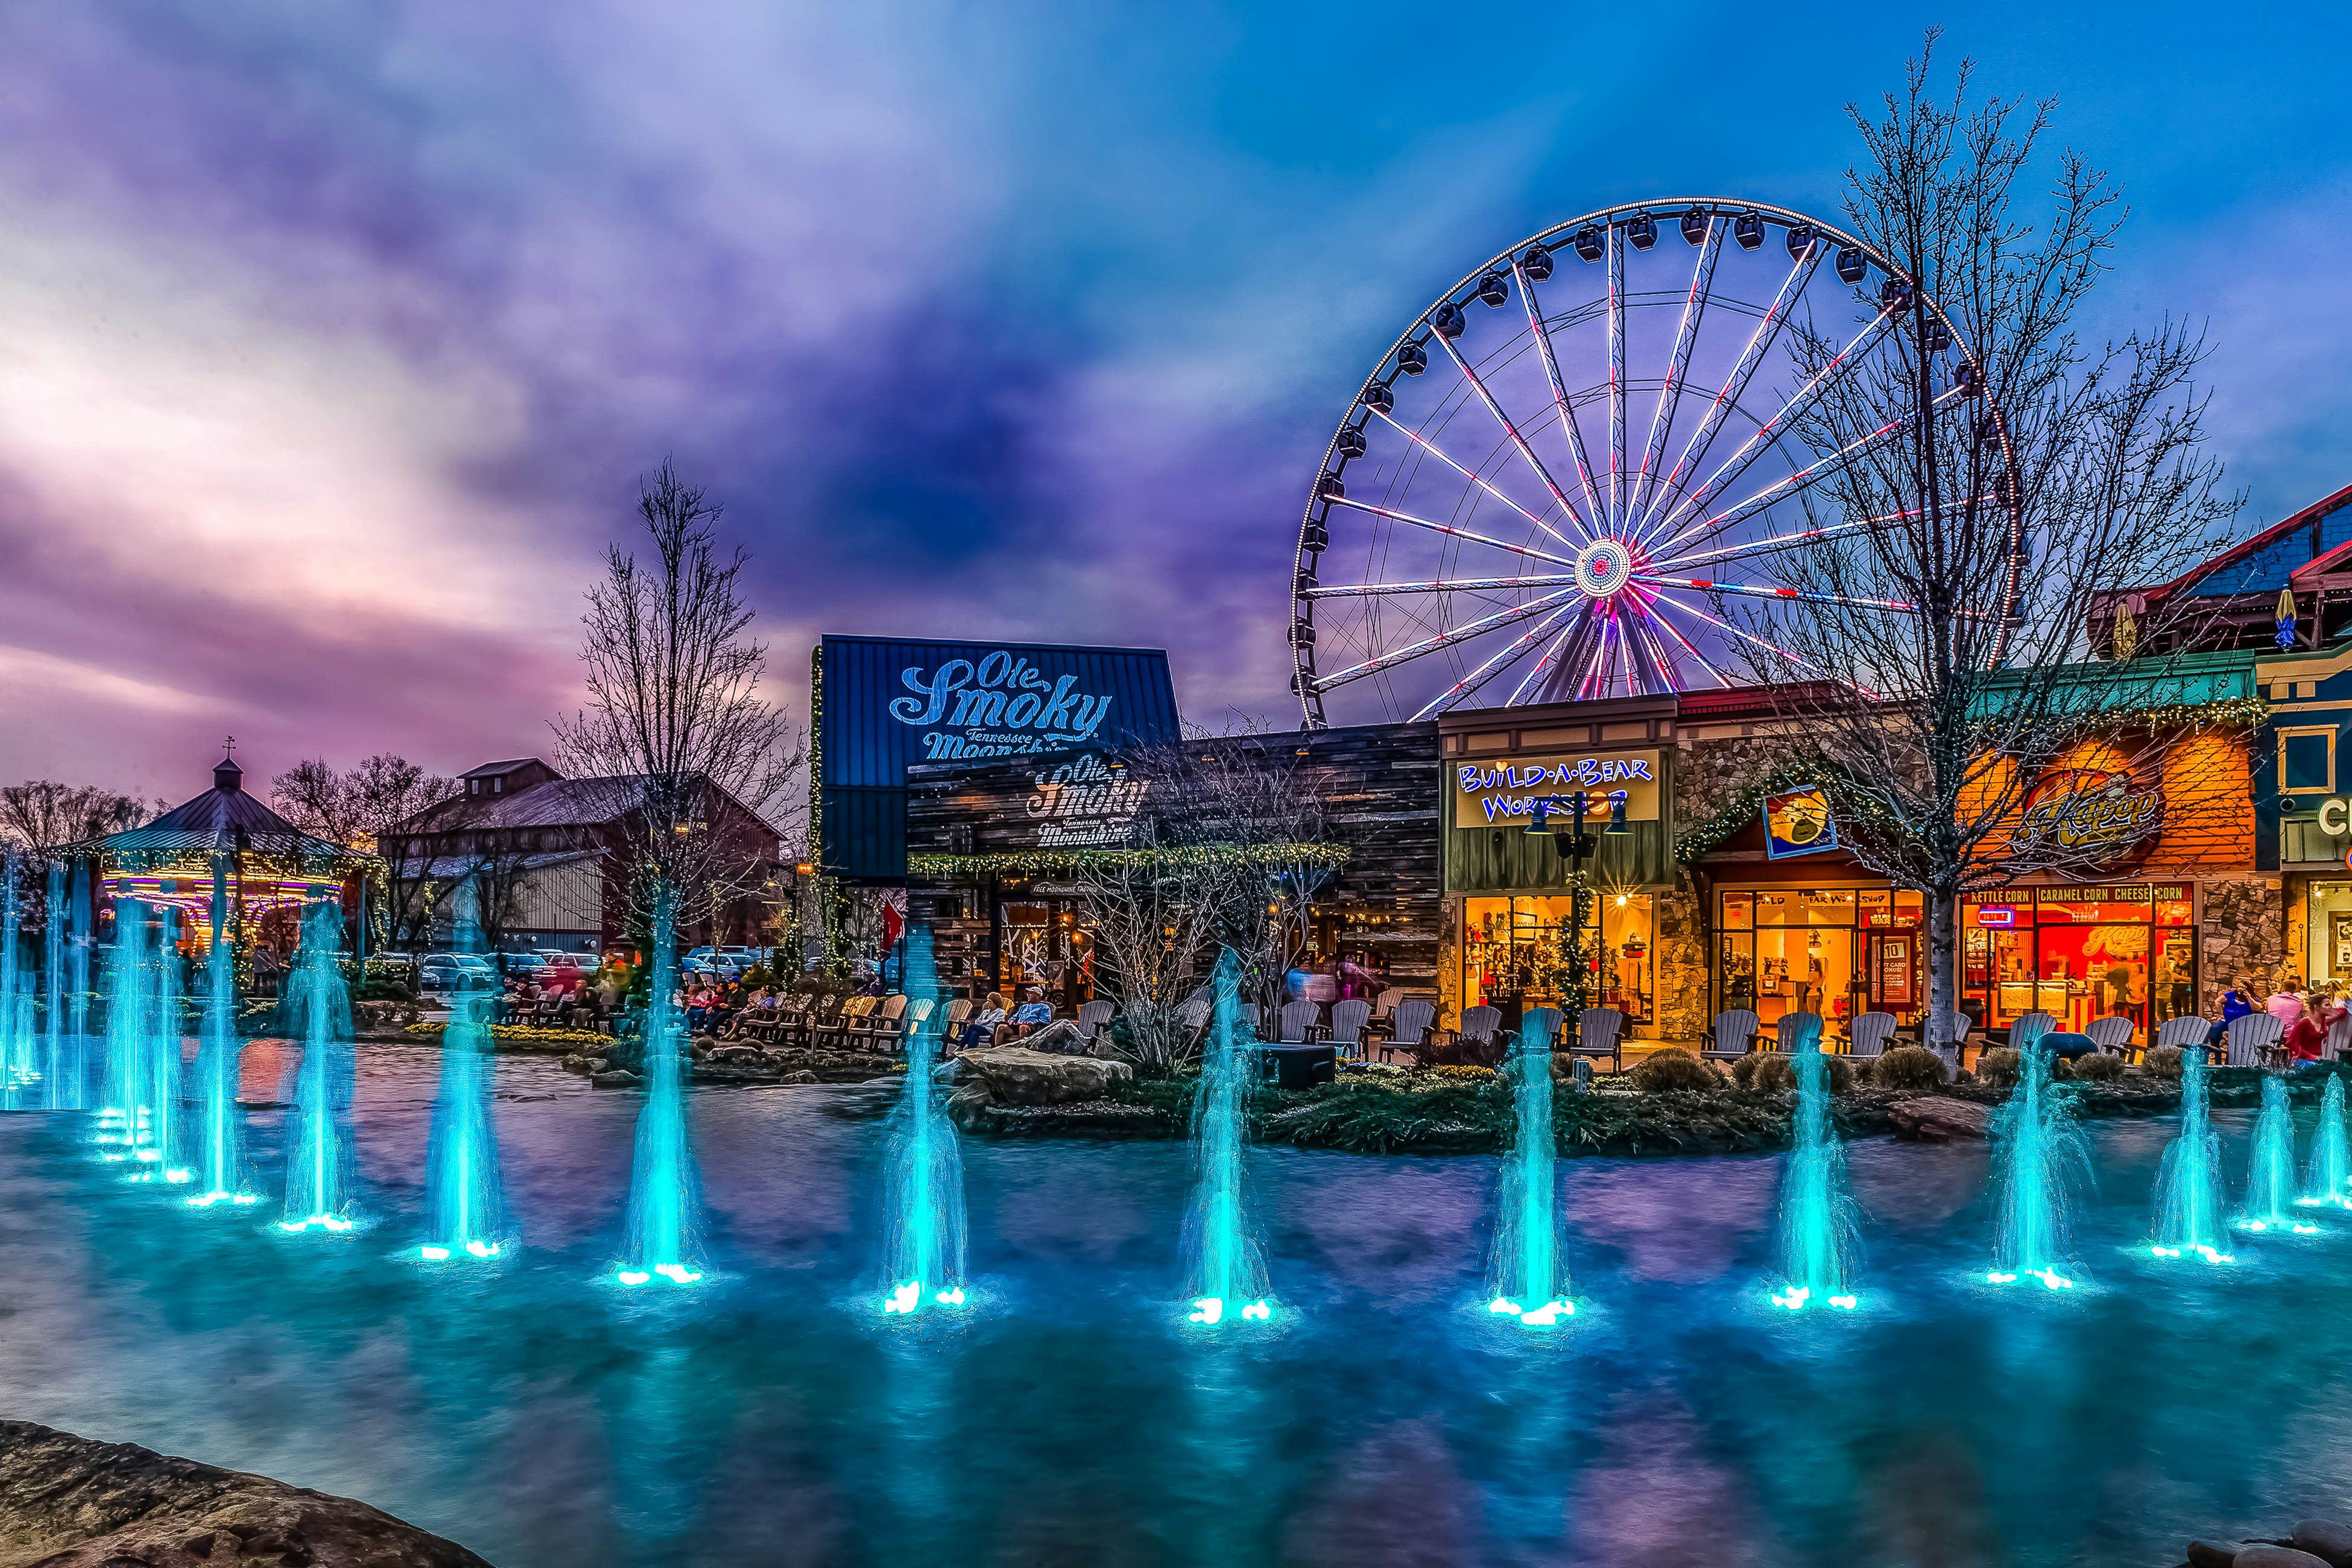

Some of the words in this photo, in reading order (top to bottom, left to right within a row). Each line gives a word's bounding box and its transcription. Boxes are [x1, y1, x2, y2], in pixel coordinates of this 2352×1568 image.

[977, 650, 1051, 692] Ole
[890, 659, 1112, 742] Smoky
[966, 728, 1032, 744] Tennessee
[1026, 765, 1151, 824] Smoky
[1037, 823, 1133, 847] Moonshine
[1971, 891, 2003, 903] KETTLE
[2005, 891, 2029, 902] CORN
[2041, 889, 2081, 901] CARAMEL
[2084, 889, 2108, 901] CORN
[2115, 888, 2149, 900] CHEESE
[2158, 887, 2183, 899] CORN
